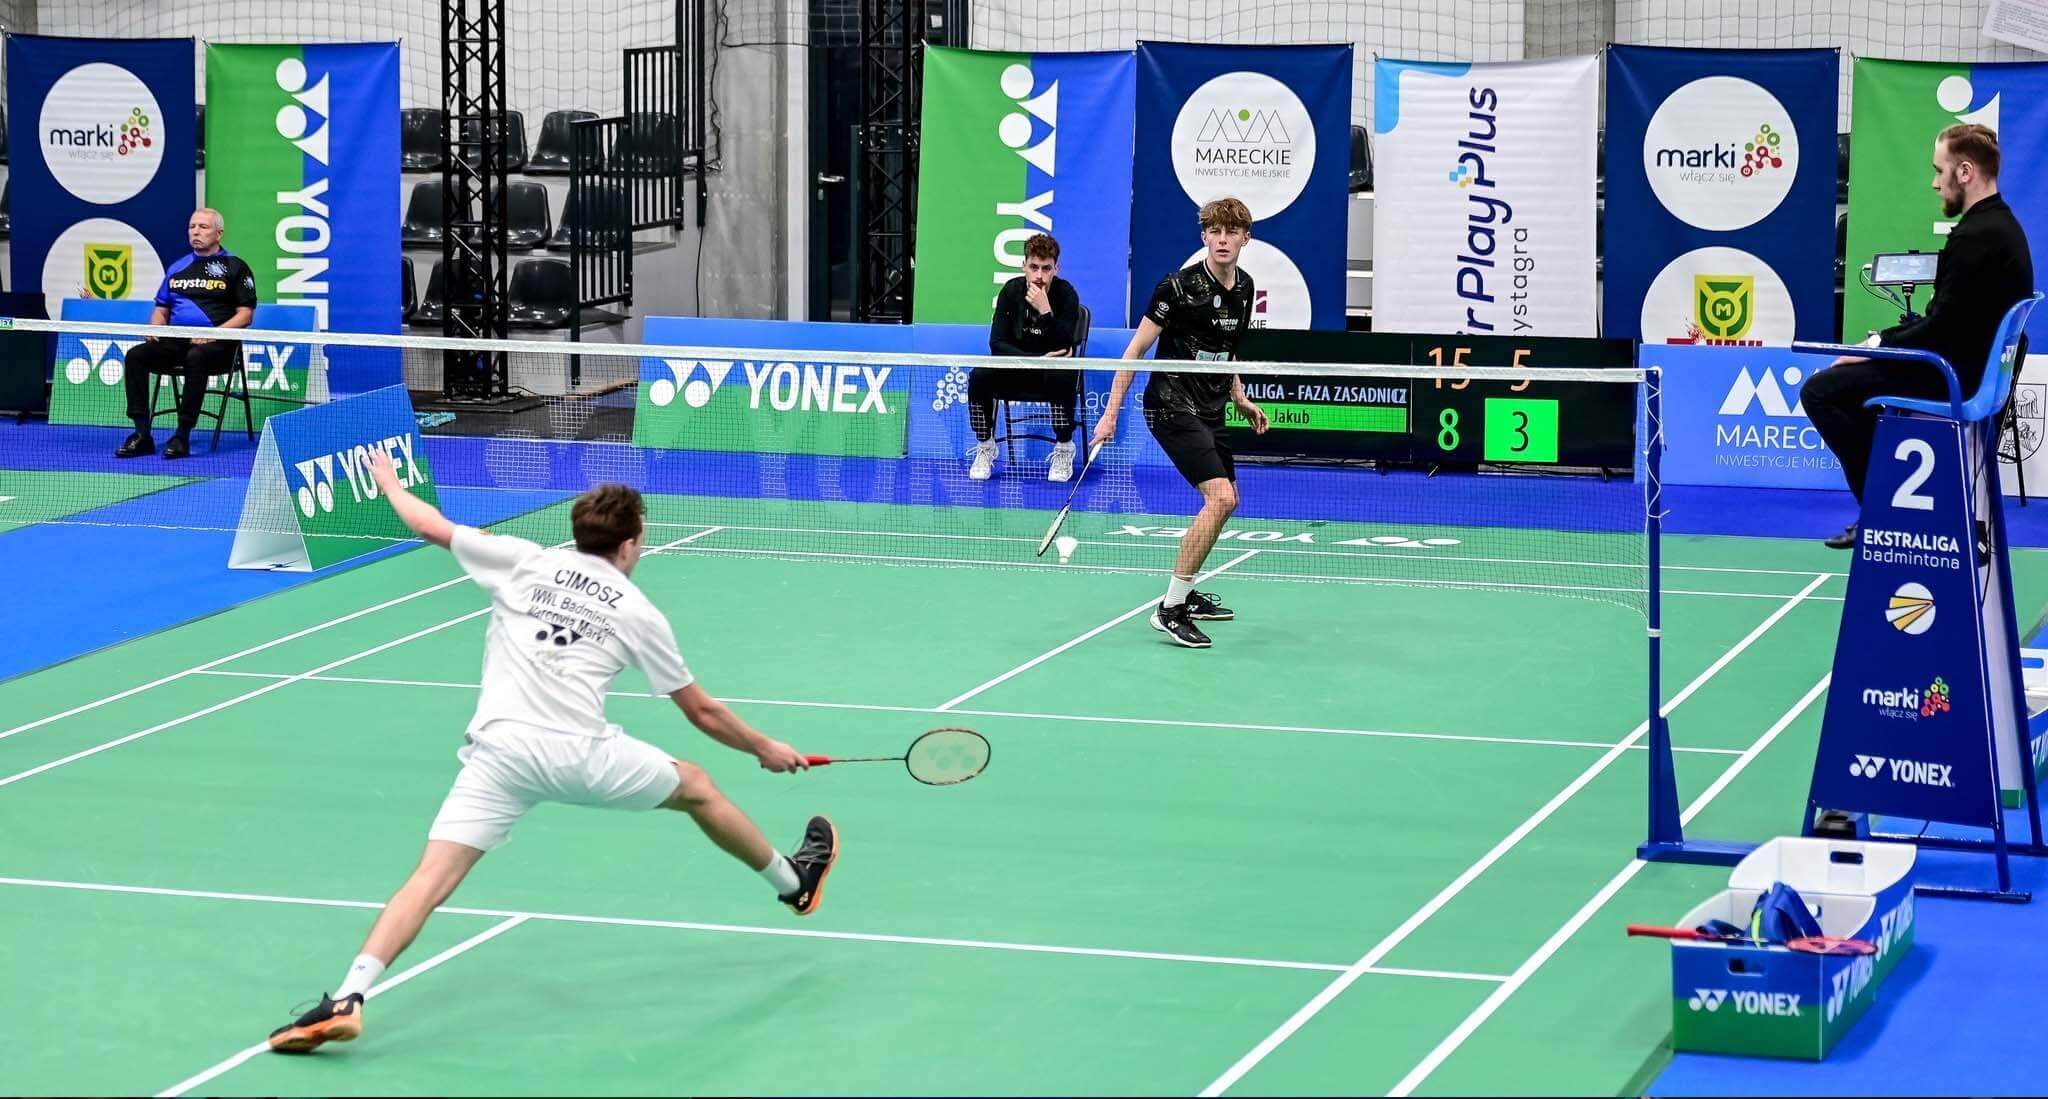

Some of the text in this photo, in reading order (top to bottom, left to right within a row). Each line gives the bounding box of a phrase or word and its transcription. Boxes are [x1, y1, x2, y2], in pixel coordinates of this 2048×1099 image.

[50, 124, 113, 147] marki
[1458, 87, 1498, 188] Plus
[1195, 148, 1291, 165] MARECKIE
[1657, 143, 1736, 168] marki
[1195, 168, 1291, 178] INWESTYCJE MIEJSKIE
[1680, 170, 1736, 185] włącz się
[1457, 195, 1512, 303] Play
[275, 178, 331, 370] YON
[1510, 228, 1534, 336] ystagra
[1249, 320, 1267, 329] KIE
[1428, 347, 1531, 391] 15 5
[743, 362, 892, 414] YONEX
[1298, 385, 1330, 401] FAZA
[1272, 409, 1310, 424] Jakub
[1438, 408, 1459, 451] 8
[1510, 411, 1529, 452] 3
[1715, 425, 1826, 450] MAREC
[336, 432, 424, 503] YOEX
[1715, 454, 1842, 470] INWESTYCJE MIEJS
[1891, 438, 1936, 511] 2
[1863, 528, 1960, 553] EKSTRALIGA
[1863, 546, 1960, 570] badmintona
[554, 569, 624, 609] CIMOSZ
[1863, 687, 1918, 709] marki
[1879, 707, 1918, 721] włącz się
[1888, 758, 1952, 787] YONEX
[1732, 990, 1800, 1017] YONEX
